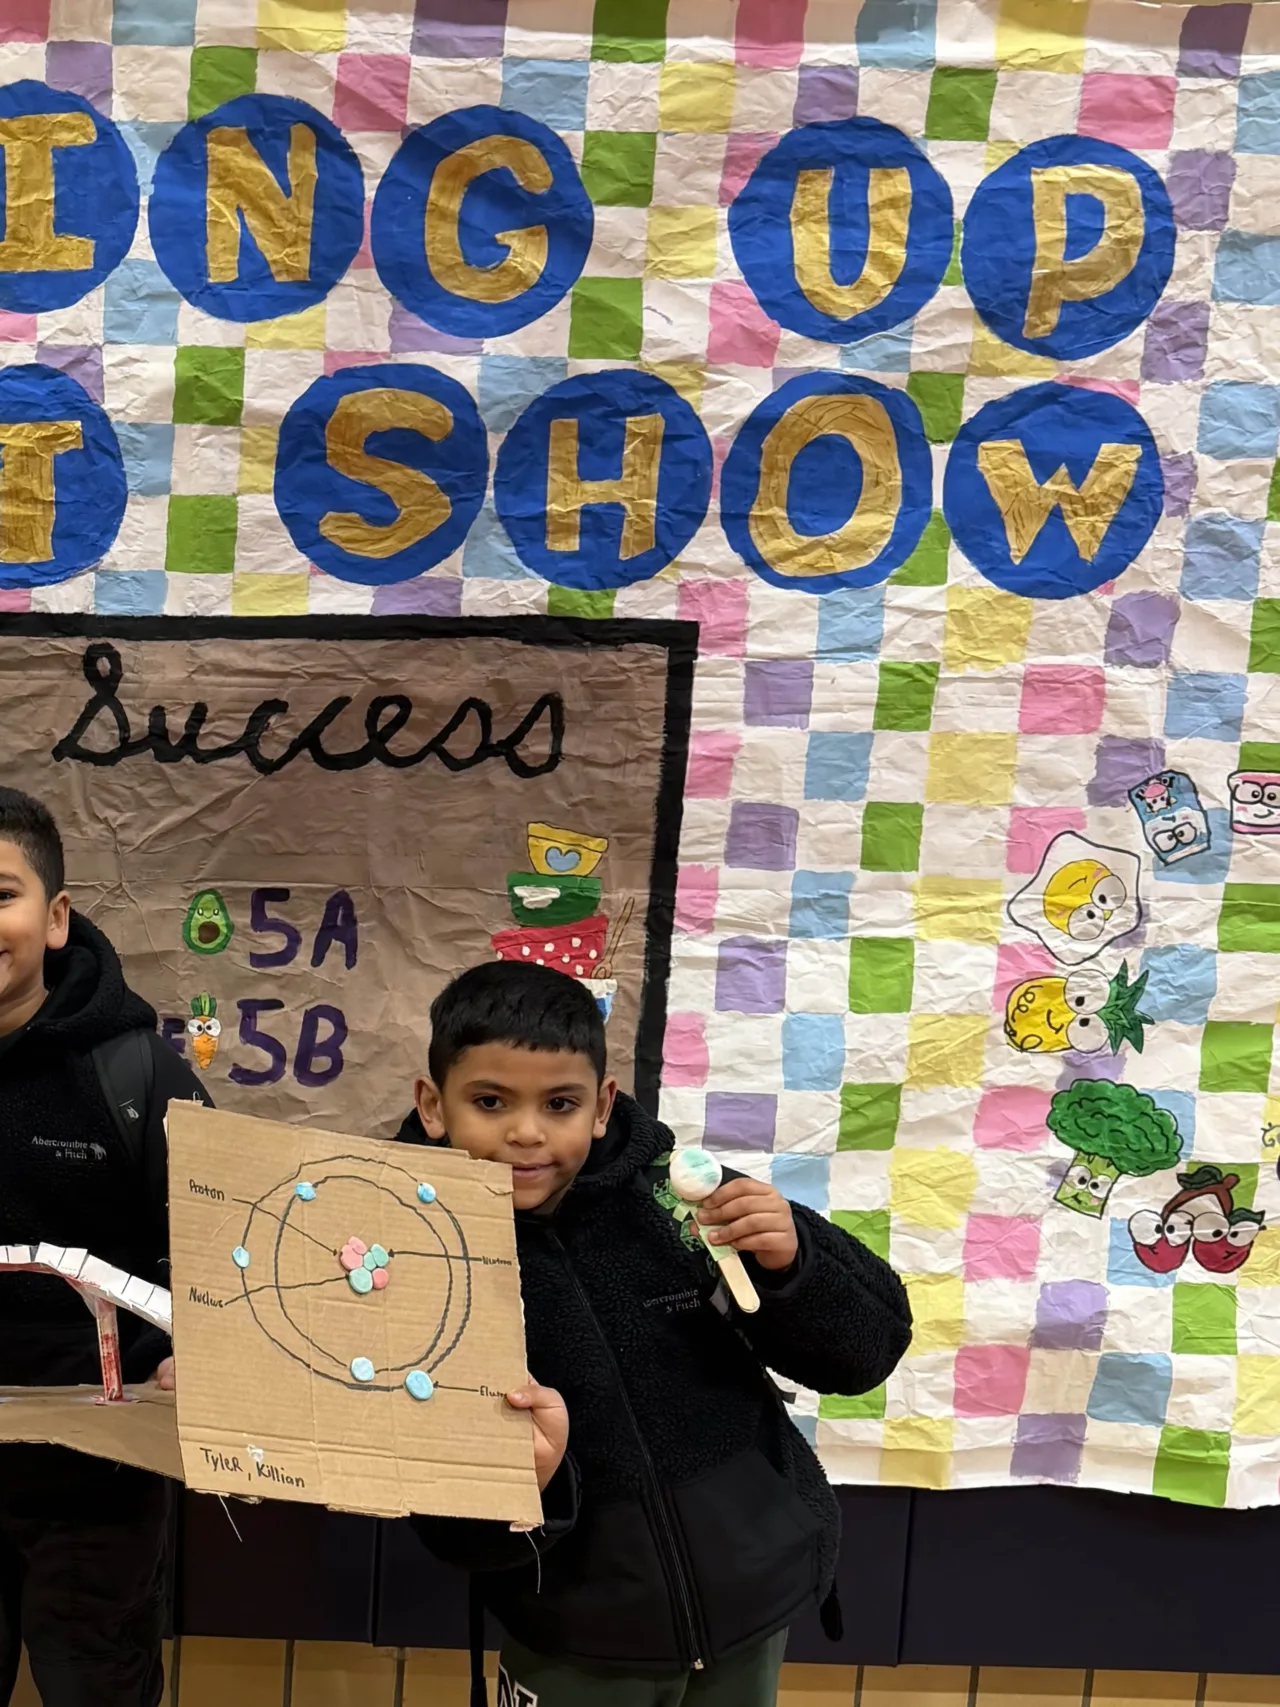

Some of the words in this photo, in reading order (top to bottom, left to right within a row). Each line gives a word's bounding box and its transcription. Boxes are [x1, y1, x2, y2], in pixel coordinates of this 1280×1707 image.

[788, 163, 1147, 339] UP
[317, 387, 1143, 578] SHOW
[52, 642, 565, 776] Success
[248, 886, 358, 970] 5A
[228, 998, 348, 1088] 5B
[31, 1136, 88, 1149] Abercrombie
[256, 1461, 305, 1488] Killian
